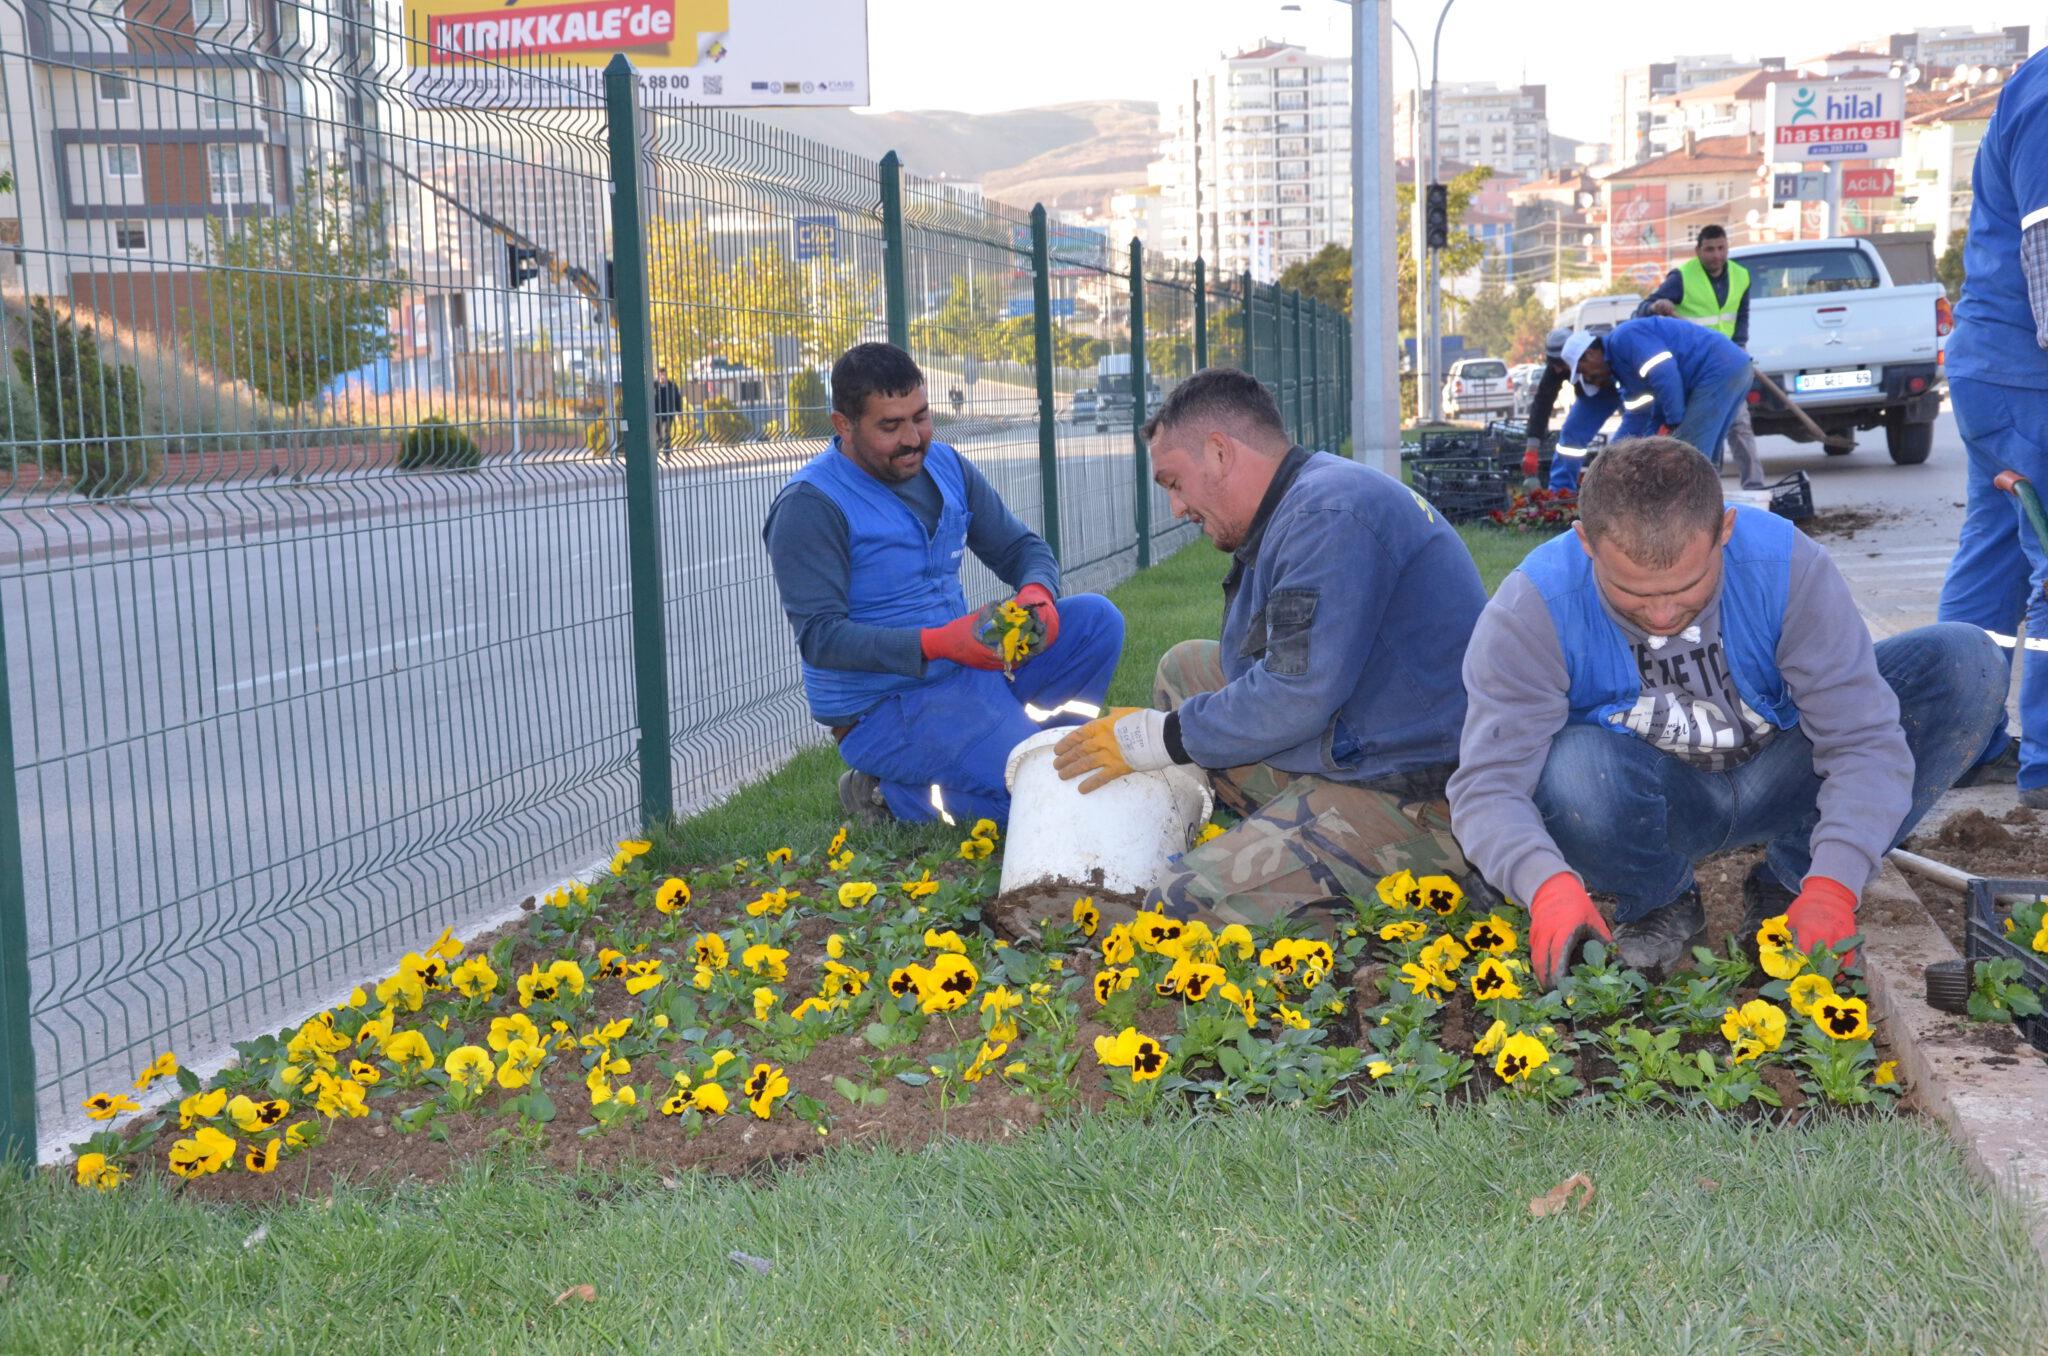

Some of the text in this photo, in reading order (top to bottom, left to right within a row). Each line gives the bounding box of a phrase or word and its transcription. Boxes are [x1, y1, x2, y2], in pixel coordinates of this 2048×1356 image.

[437, 6, 672, 54] KIRIKKALE'de
[649, 75, 667, 89] 88
[671, 75, 690, 89] 00
[1826, 93, 1882, 120] hilal
[1780, 121, 1896, 143] hastanesi
[1780, 179, 1792, 195] H
